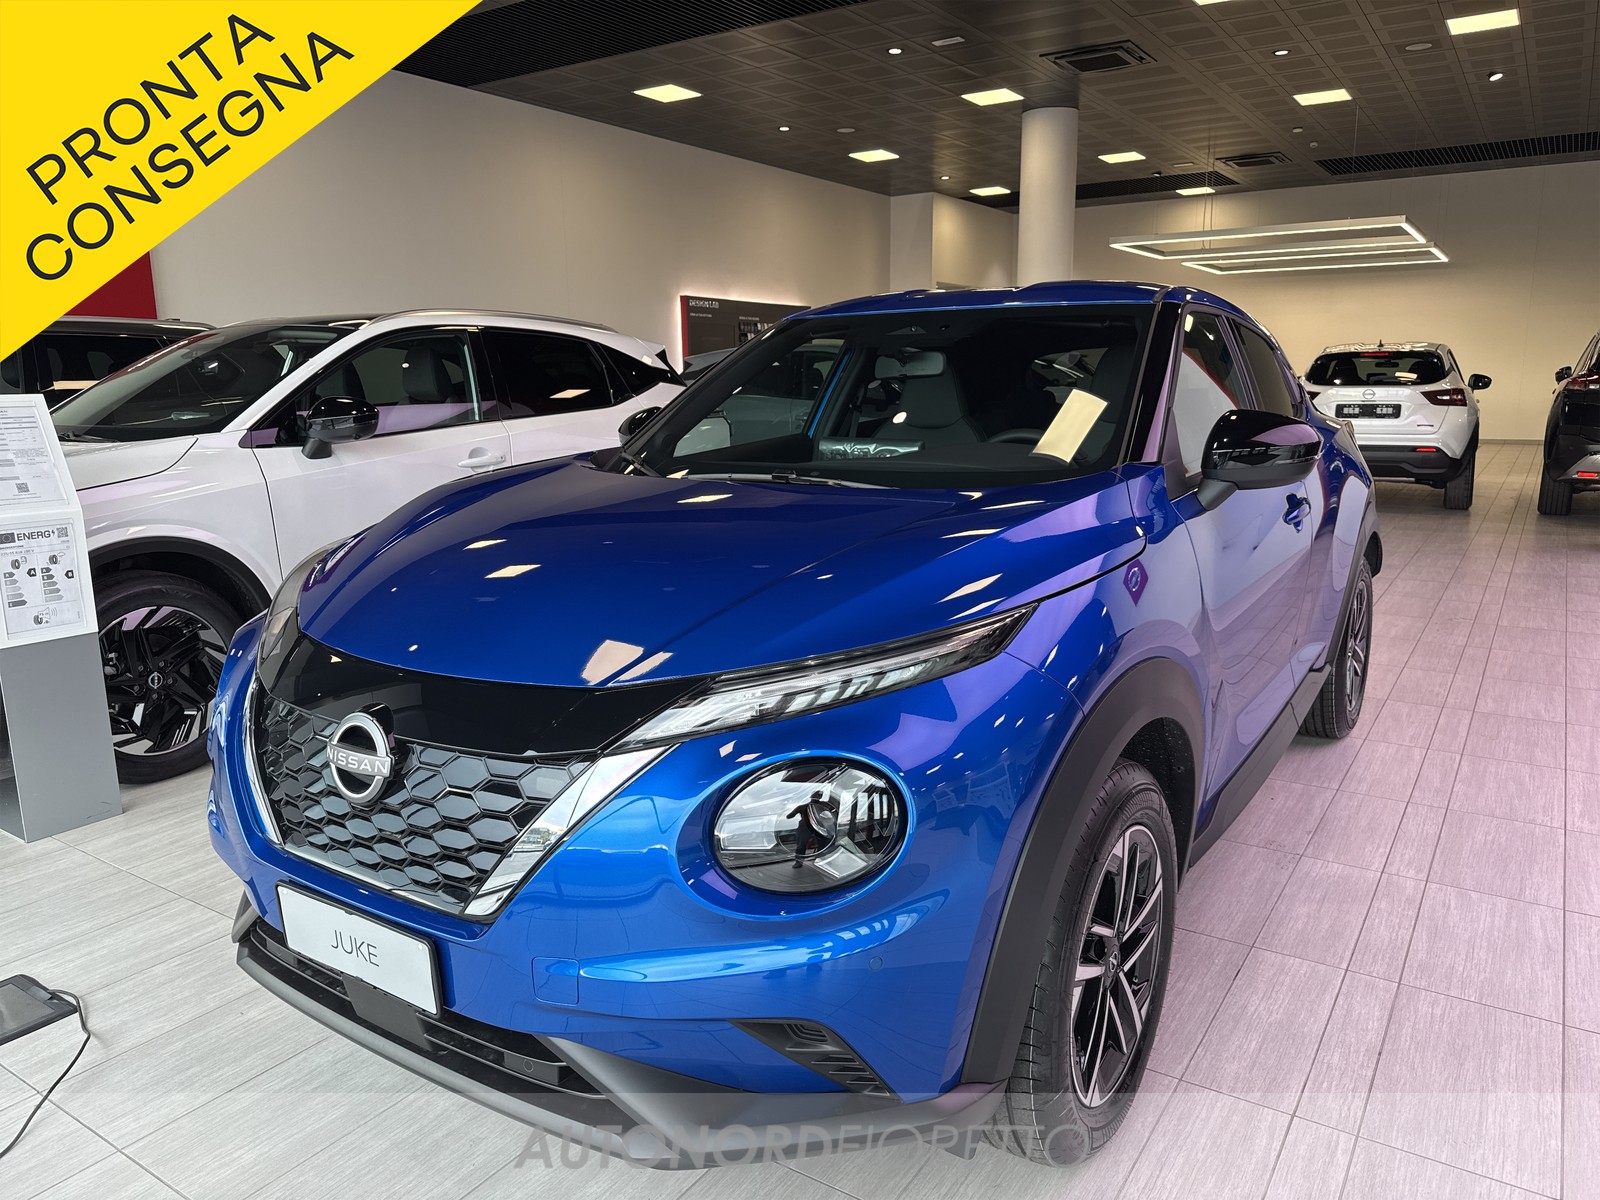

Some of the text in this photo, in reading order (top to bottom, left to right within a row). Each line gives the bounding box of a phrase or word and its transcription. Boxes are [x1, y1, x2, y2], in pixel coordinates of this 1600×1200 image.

[16, 530, 51, 541] ENERG
[326, 745, 389, 774] NISSAN
[331, 929, 380, 968] JUKE
